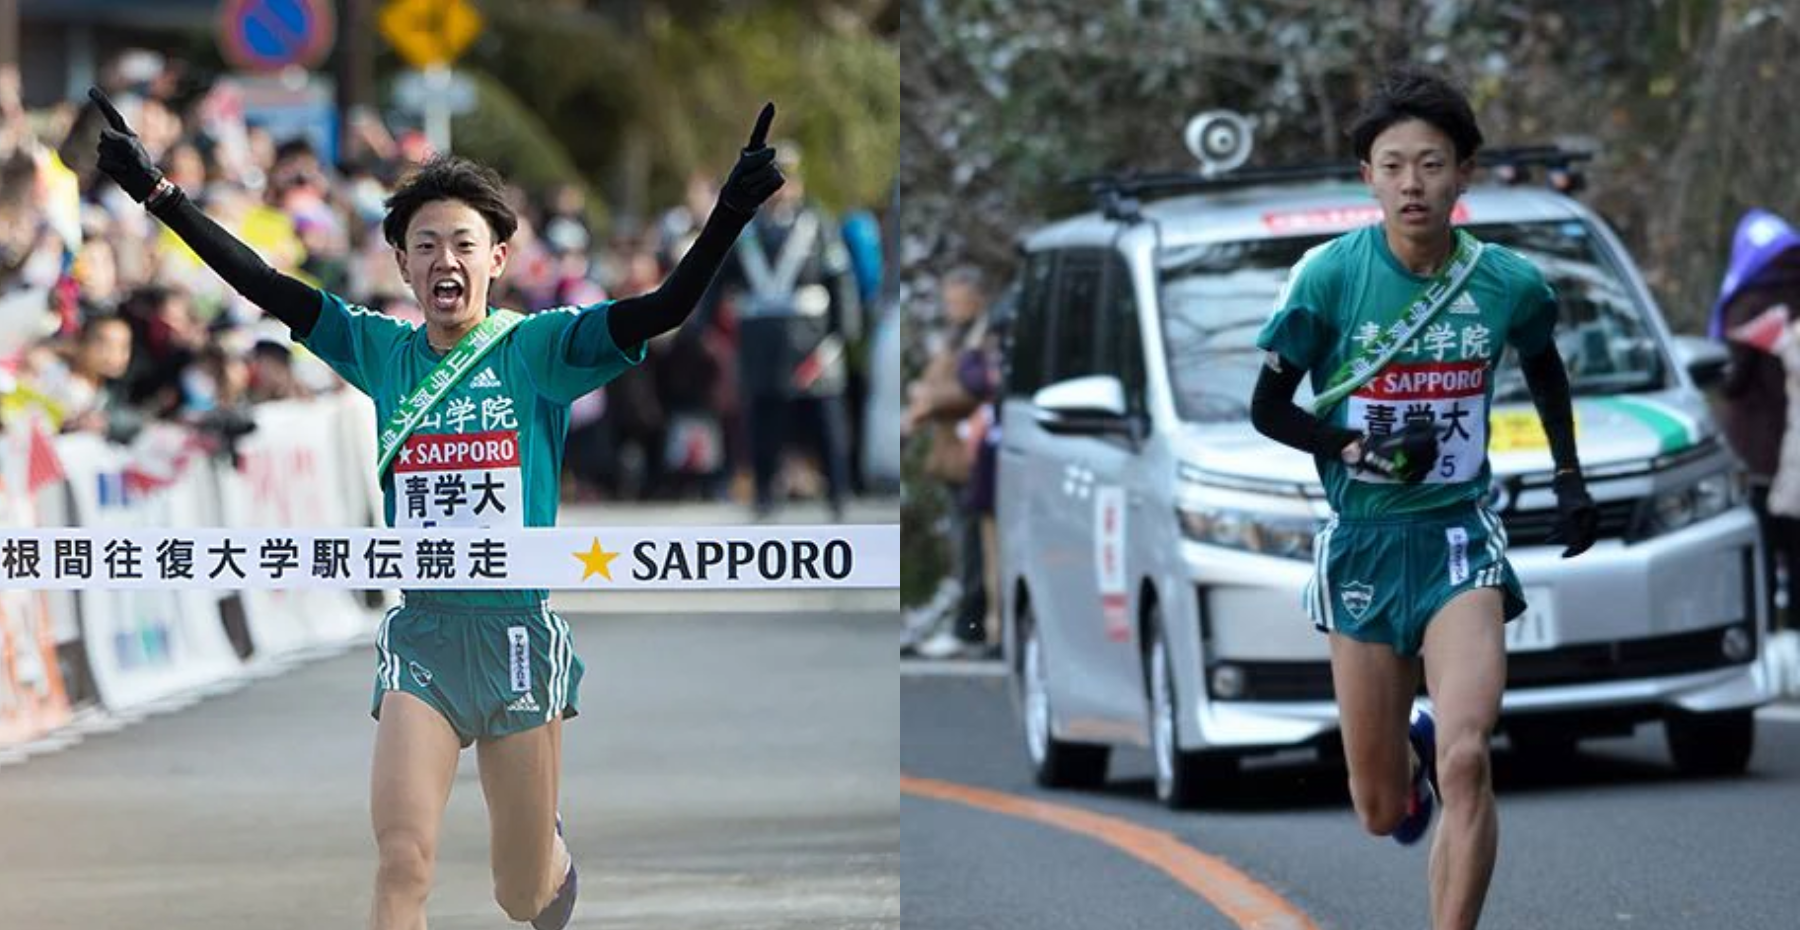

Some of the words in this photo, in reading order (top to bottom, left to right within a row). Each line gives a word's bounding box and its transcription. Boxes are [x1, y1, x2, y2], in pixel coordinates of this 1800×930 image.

[1383, 369, 1482, 394] SAPPORO
[416, 440, 514, 464] SAPPORO
[405, 472, 506, 519] 青学大
[2, 538, 509, 580] 根間往復大学駅伝競走
[632, 539, 853, 581] SAPPORO
